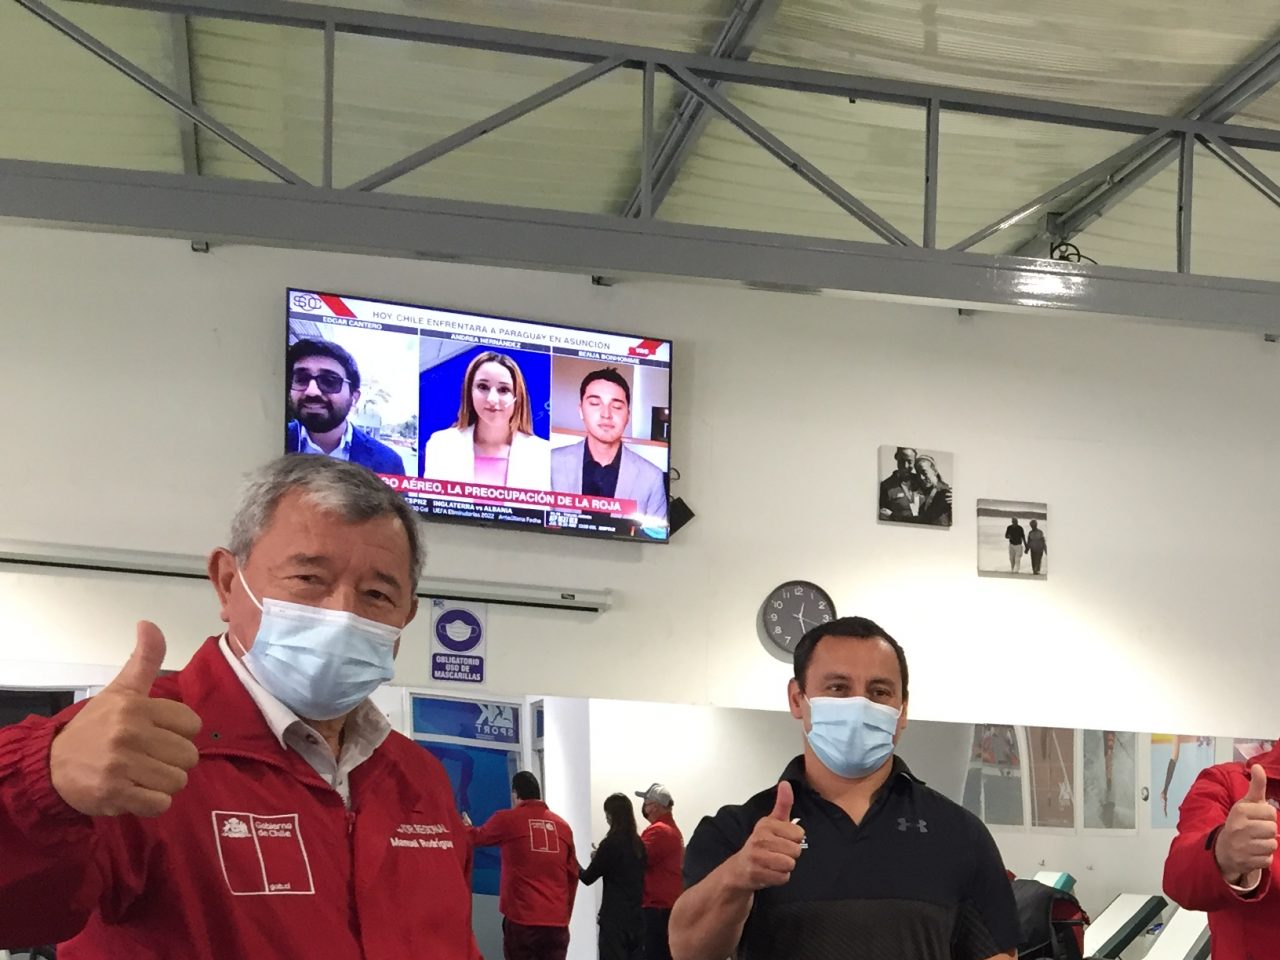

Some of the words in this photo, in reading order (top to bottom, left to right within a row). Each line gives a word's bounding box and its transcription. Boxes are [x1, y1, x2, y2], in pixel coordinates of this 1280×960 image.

[322, 316, 347, 326] EDGAR
[348, 319, 383, 330] CANTERO
[373, 311, 392, 321] HOY
[397, 314, 424, 324] CHILE
[427, 318, 487, 334] ENFRENTARA
[499, 328, 546, 340] PARAGUAY
[549, 335, 562, 343] EN
[450, 333, 479, 343] ANDREA
[578, 350, 600, 359] BENJA
[401, 477, 445, 494] AÉREO,
[447, 483, 462, 494] LA
[464, 485, 556, 504] PREOCUPACIÓN
[557, 495, 573, 506] DE
[575, 497, 589, 508] LA
[592, 499, 622, 511] ROJA
[432, 500, 475, 510] INGLATERRA
[483, 505, 513, 514] ALBANIA
[794, 587, 804, 596] 12
[818, 601, 826, 610] 2
[770, 613, 778, 621] 9
[822, 614, 830, 623] 3
[775, 625, 782, 634] 8
[785, 636, 791, 646] 7
[435, 655, 480, 666] OBLIGATORIO
[434, 670, 480, 680] MASCARILLAS
[255, 821, 293, 830] Gobierno
[257, 829, 269, 837] de
[269, 829, 292, 837] Chile
